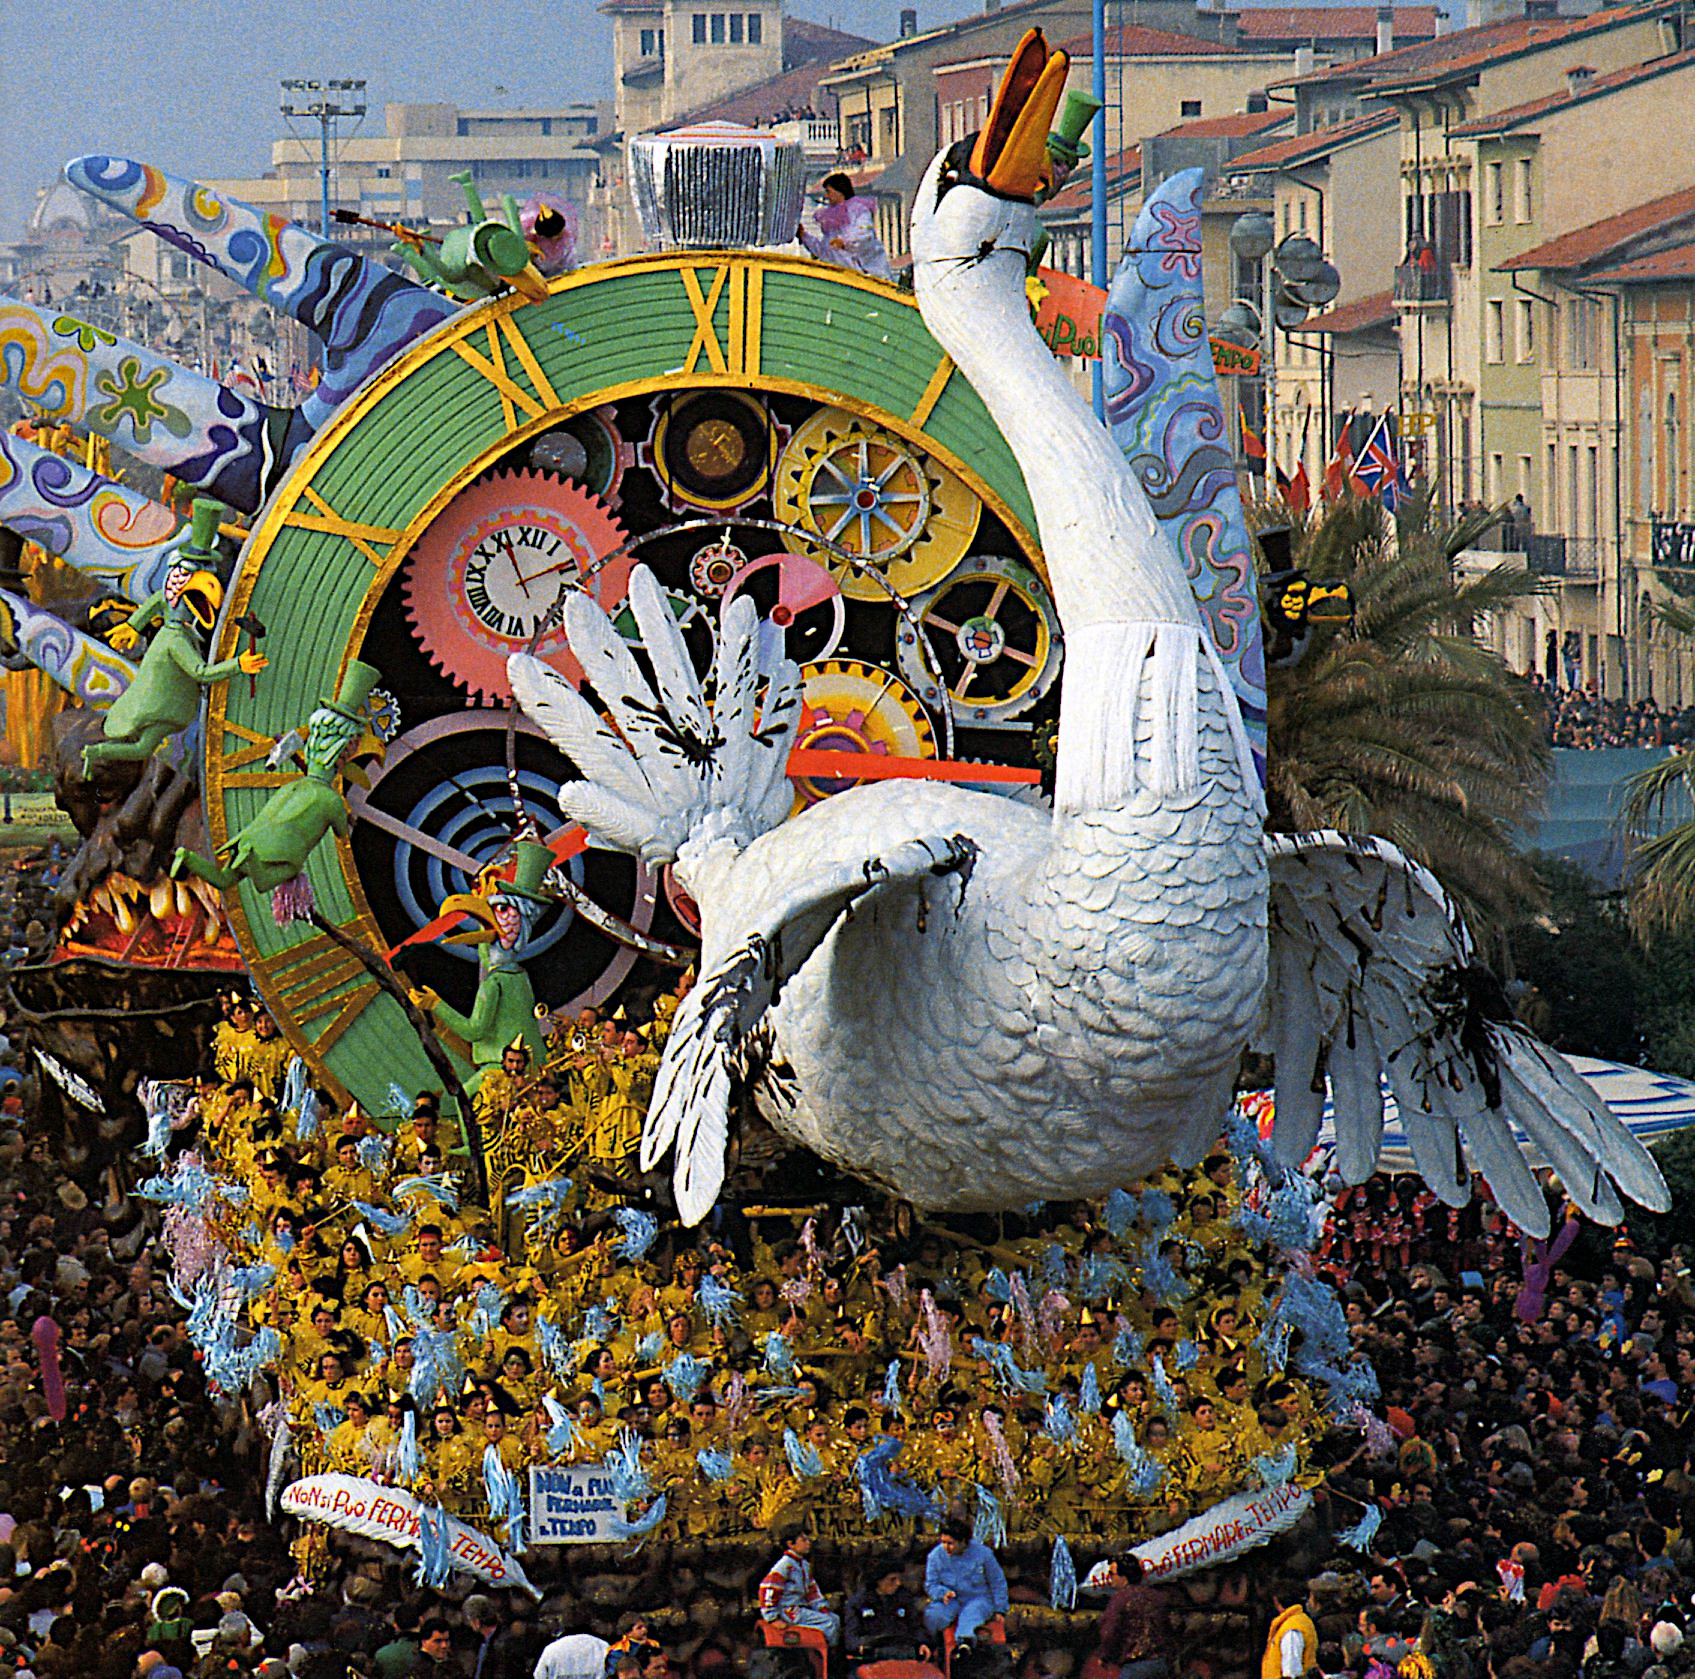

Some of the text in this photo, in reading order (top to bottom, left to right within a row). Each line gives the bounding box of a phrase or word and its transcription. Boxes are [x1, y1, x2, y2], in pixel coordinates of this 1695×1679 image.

[680, 265, 763, 374] XII
[1052, 313, 1096, 356] Può
[450, 312, 562, 432] XI
[284, 486, 404, 568] X
[517, 526, 548, 549] XII
[474, 544, 496, 565] X
[490, 530, 514, 553] XI
[546, 539, 561, 556] I
[465, 562, 487, 585] IX
[467, 585, 491, 616] VIII
[482, 605, 505, 632] VII
[506, 616, 526, 637] VI
[547, 1518, 597, 1536] TEMPO
[1172, 1517, 1245, 1569] FERMARE
[1245, 1484, 1302, 1528] TEMPO
[451, 1530, 506, 1580] TEMPO
